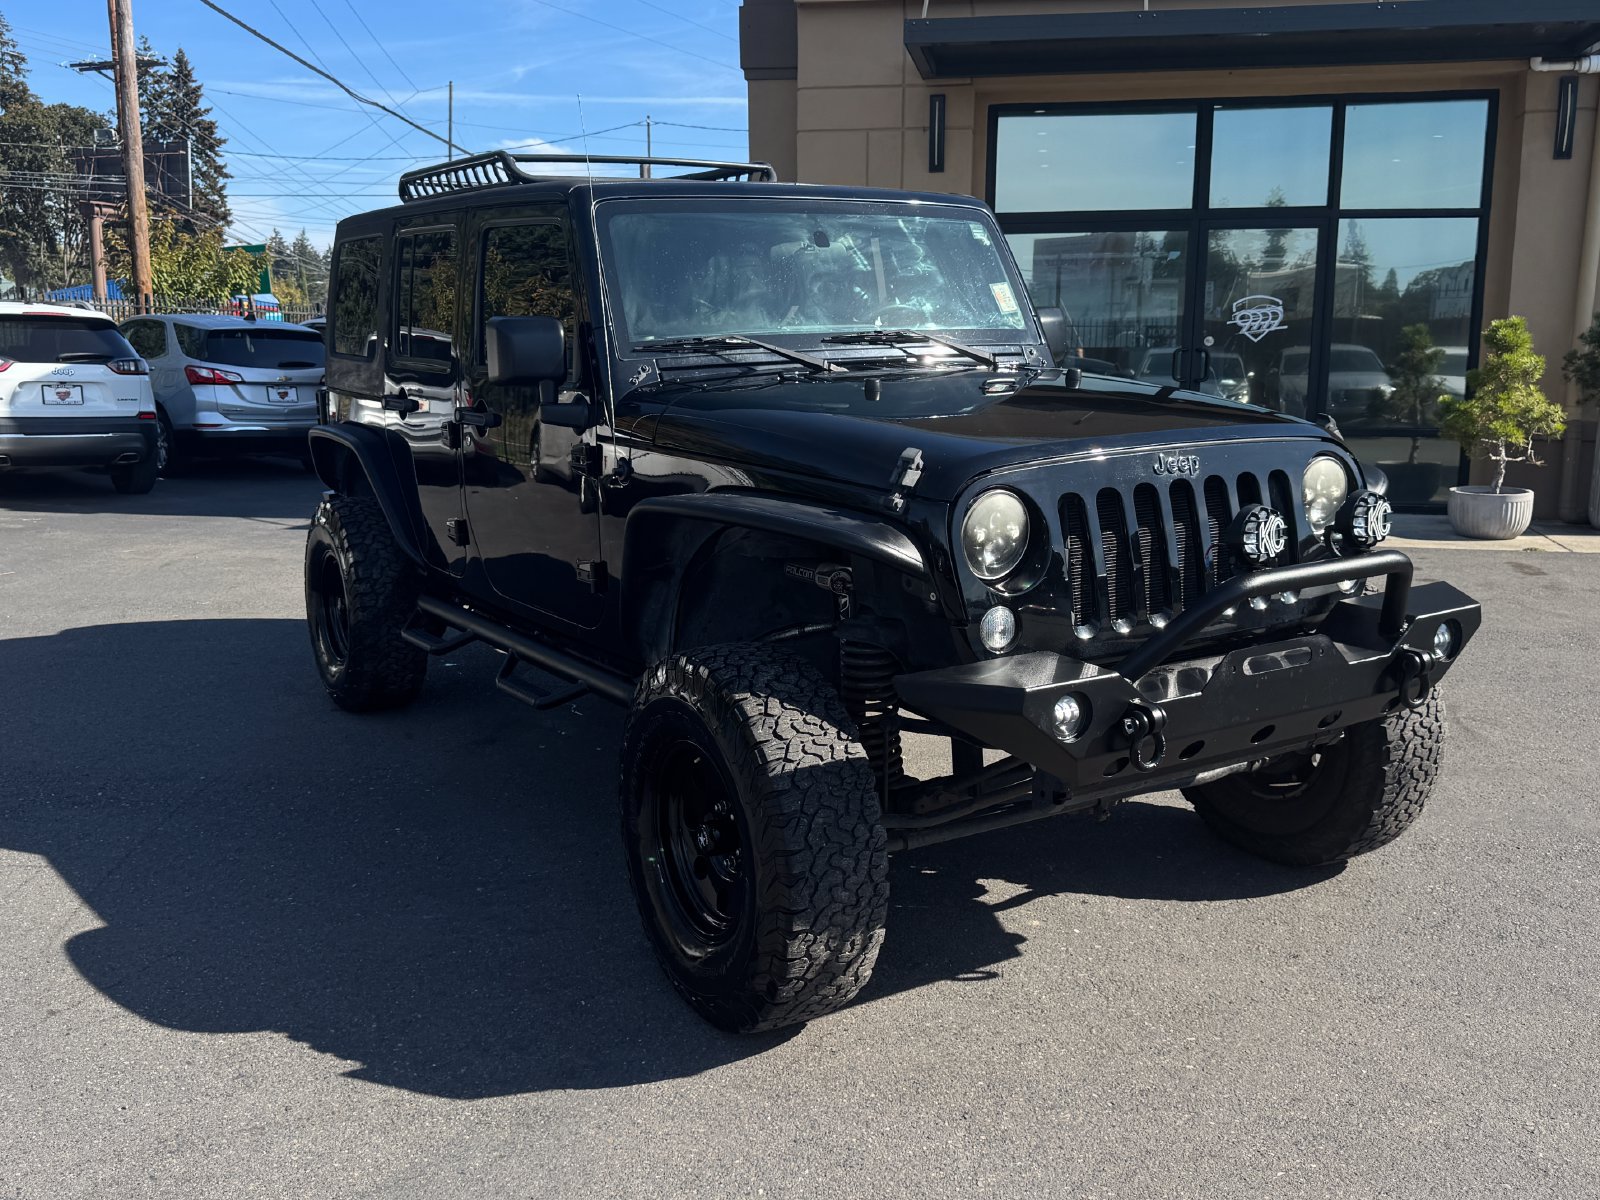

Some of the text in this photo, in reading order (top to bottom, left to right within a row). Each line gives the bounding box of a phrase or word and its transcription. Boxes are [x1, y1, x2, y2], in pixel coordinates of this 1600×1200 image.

[52, 367, 75, 377] Jeep
[1153, 453, 1200, 478] Jeep
[1259, 515, 1285, 557] KC
[1367, 500, 1391, 540] KC
